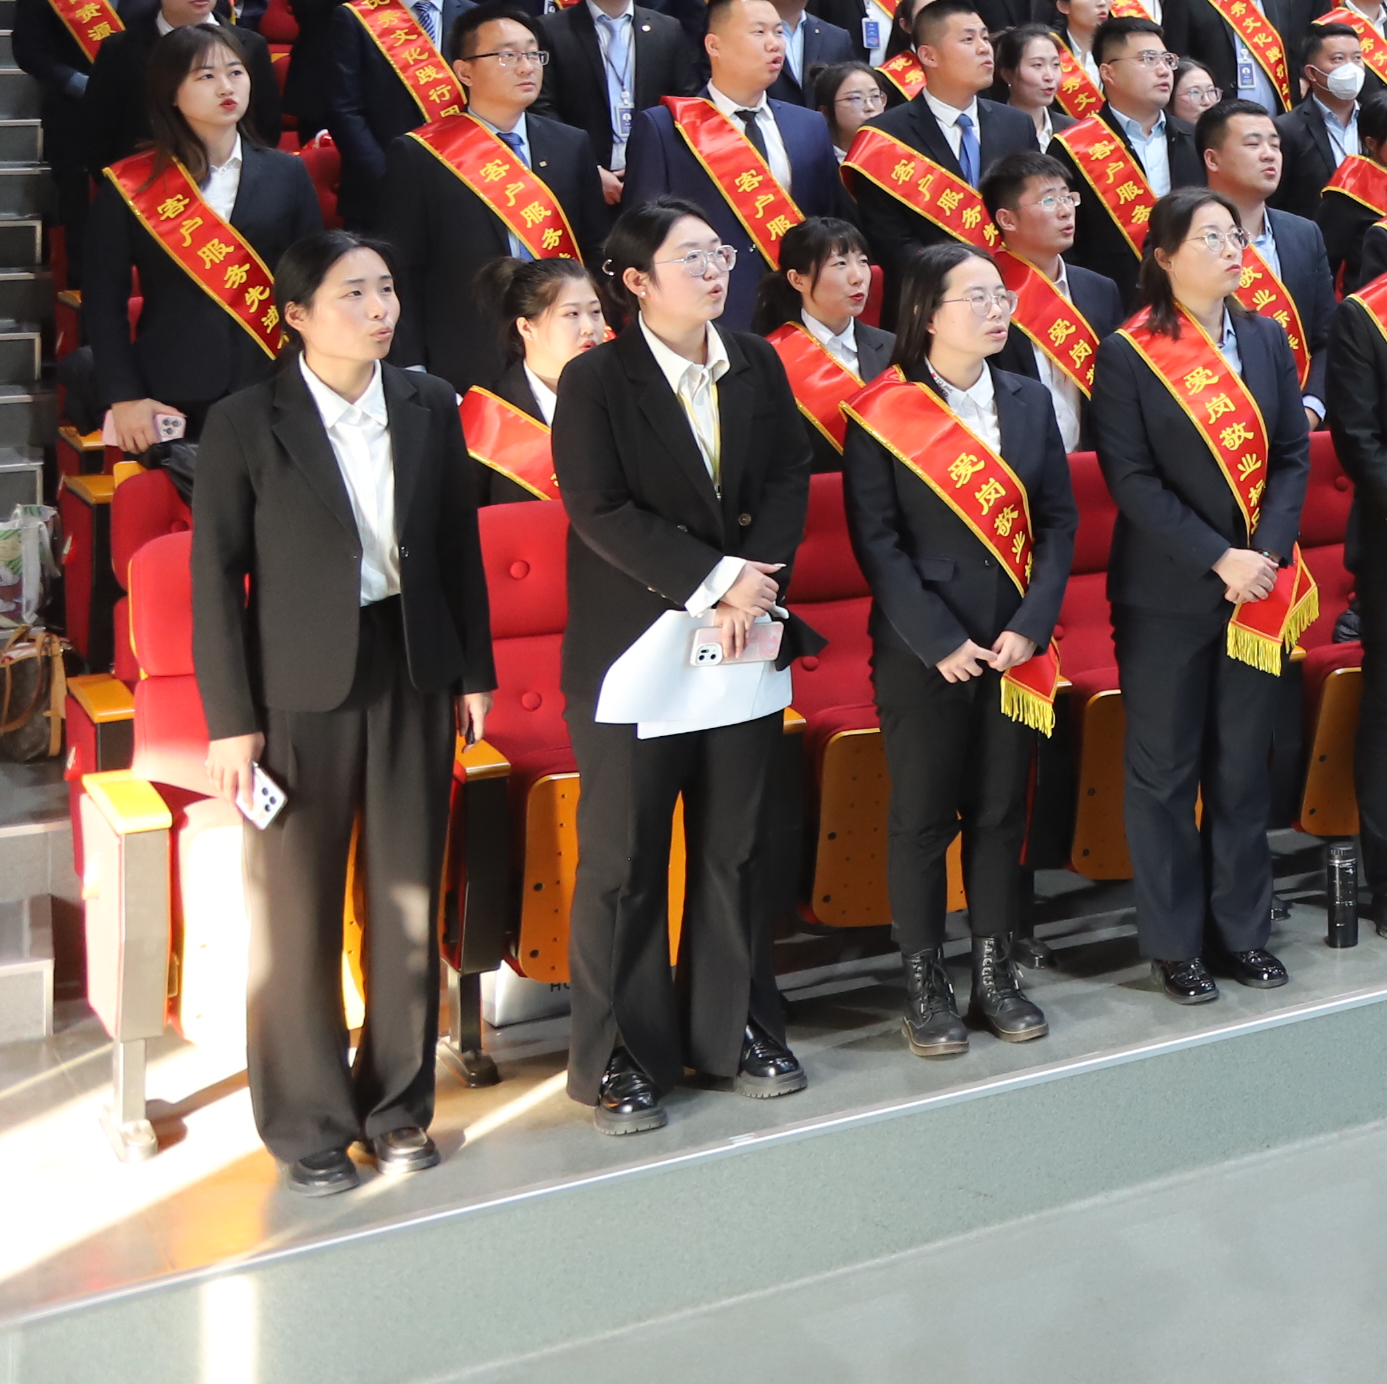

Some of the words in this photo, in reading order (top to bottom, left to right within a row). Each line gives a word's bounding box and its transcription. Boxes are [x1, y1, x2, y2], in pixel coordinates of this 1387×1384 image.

[479, 159, 571, 260] 客户服务
[1088, 140, 1152, 225] 客户服务
